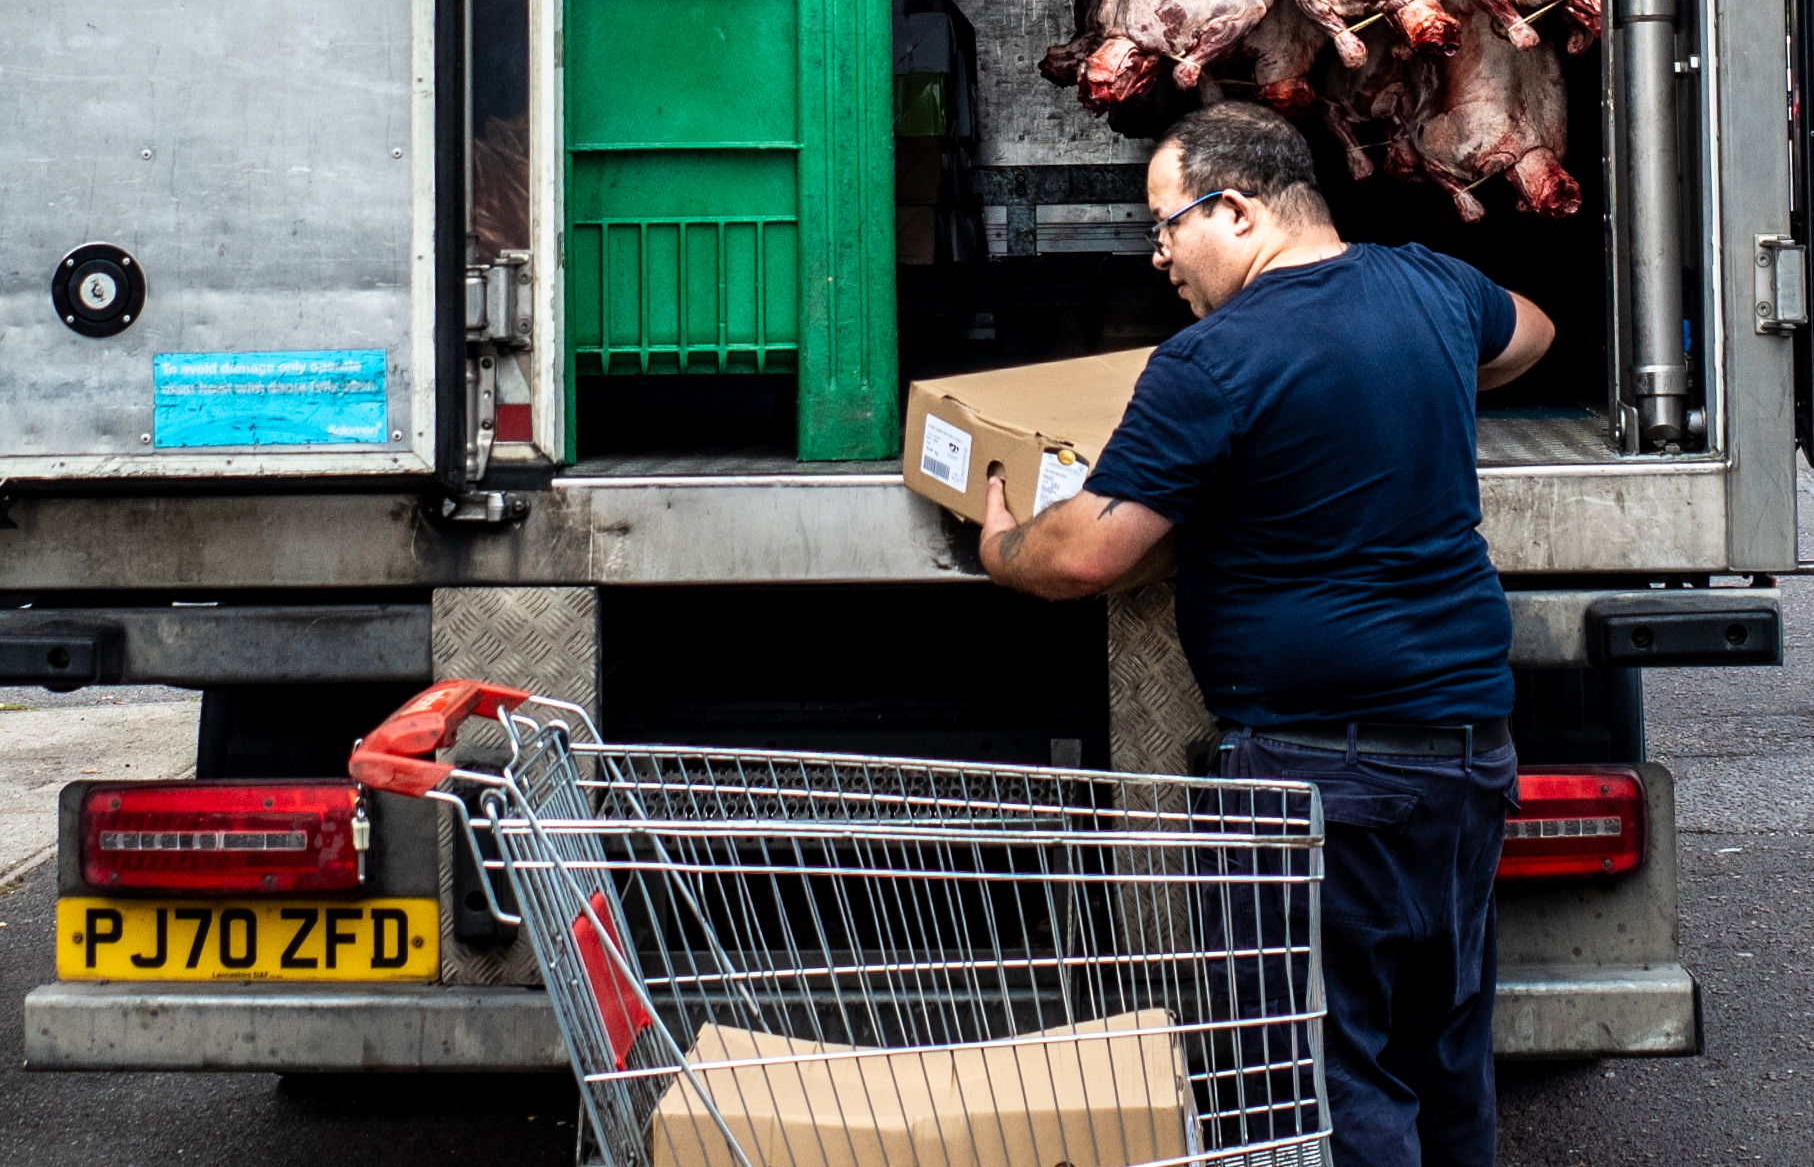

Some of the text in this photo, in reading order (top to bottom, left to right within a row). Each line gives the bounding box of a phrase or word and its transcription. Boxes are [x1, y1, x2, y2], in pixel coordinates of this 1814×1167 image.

[161, 362, 178, 375] To
[180, 361, 218, 375] avoid
[220, 361, 275, 376] damage
[278, 361, 307, 375] only
[85, 907, 409, 969] PJ70 ZFD
